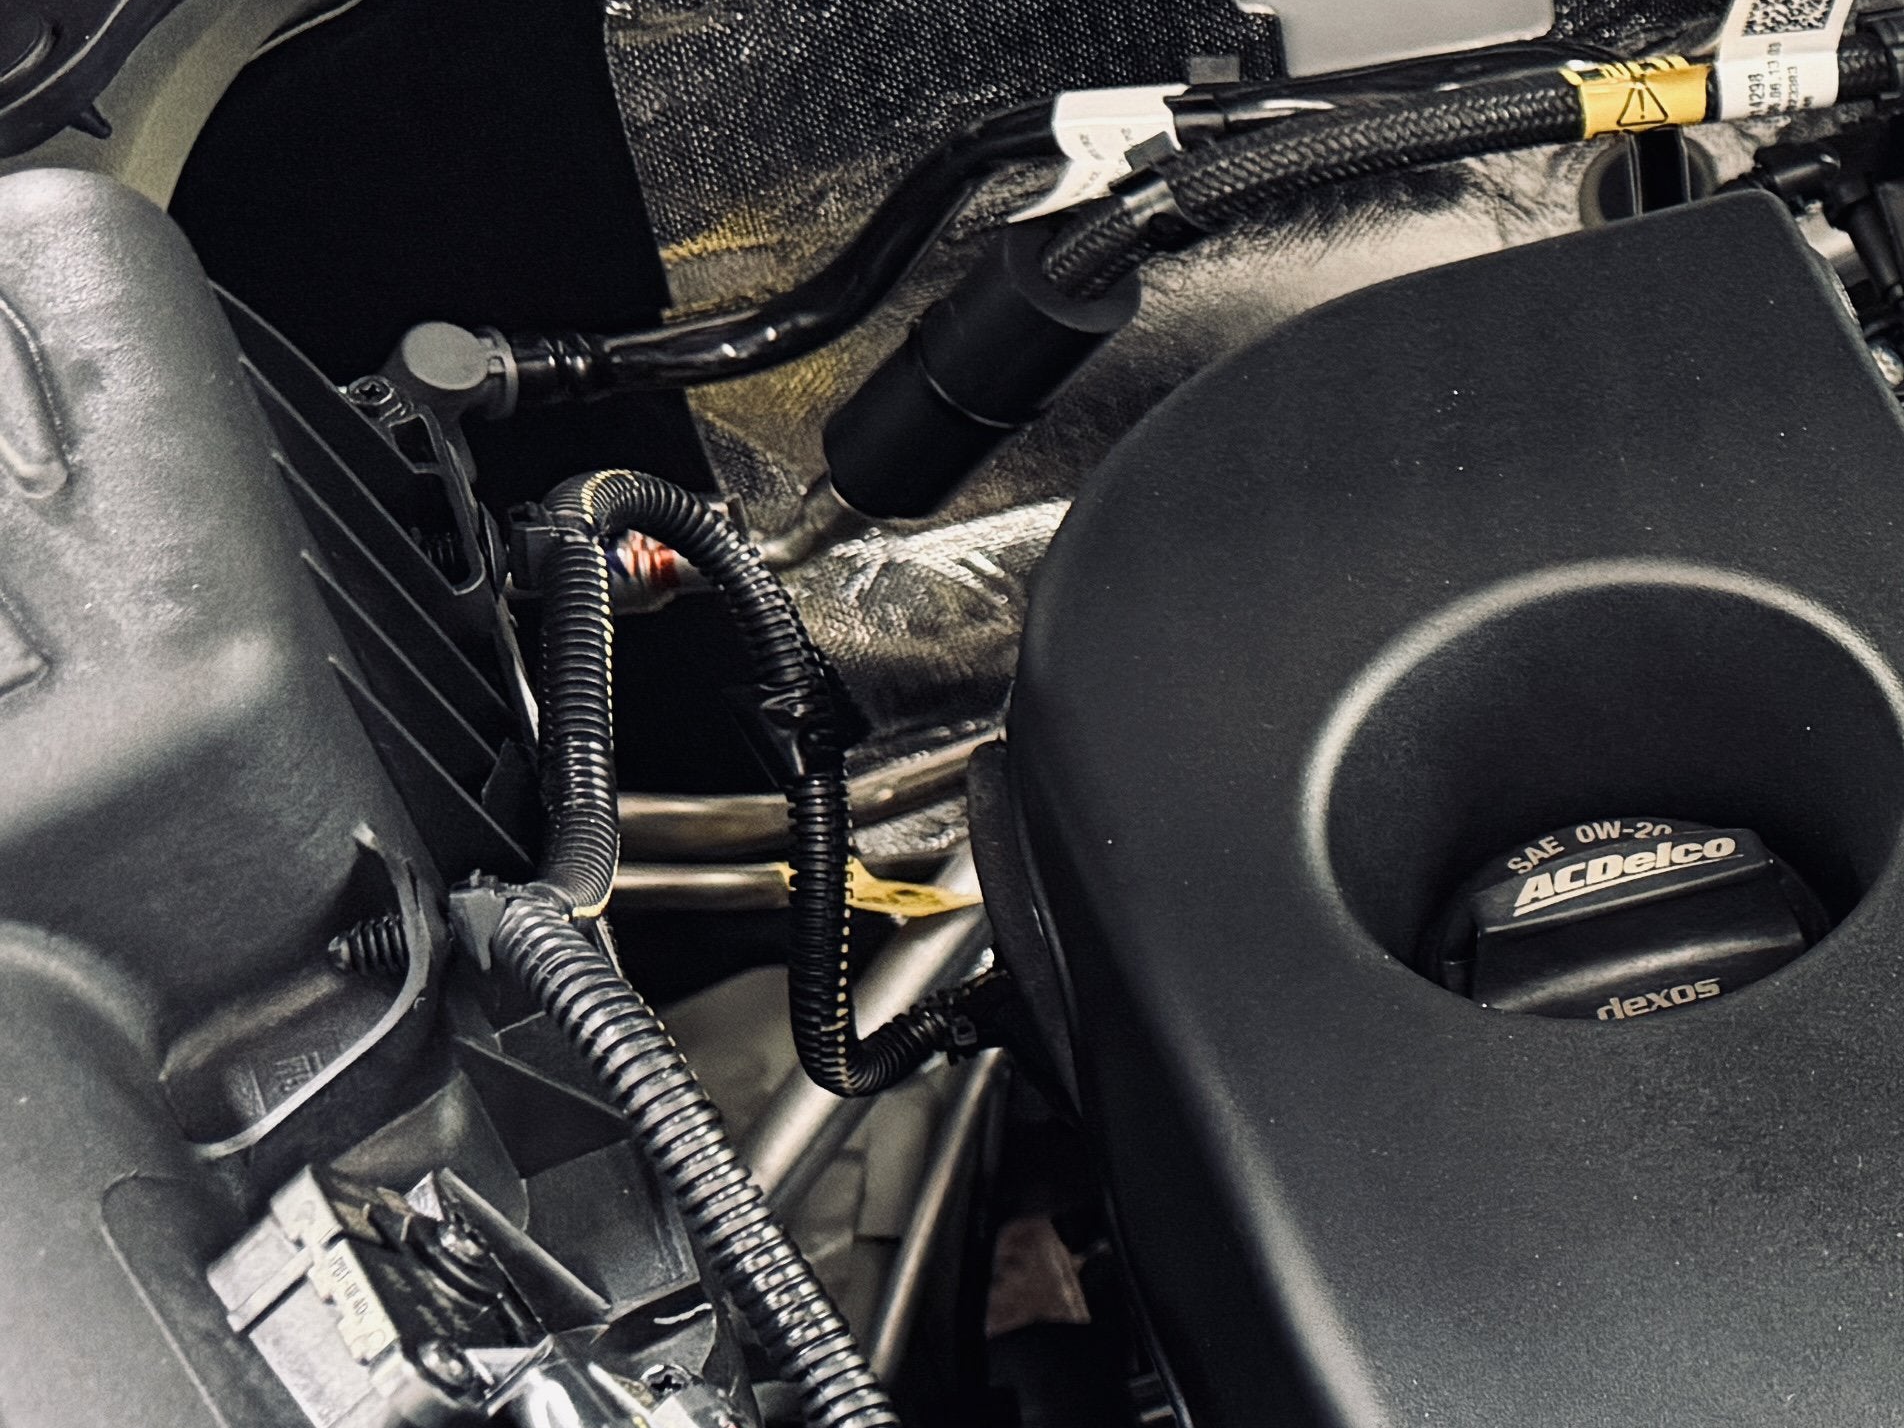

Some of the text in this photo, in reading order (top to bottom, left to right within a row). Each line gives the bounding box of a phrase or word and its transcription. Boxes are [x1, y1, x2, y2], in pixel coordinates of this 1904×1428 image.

[1507, 836, 1565, 876] SAE
[1513, 837, 1737, 908] ACDelco
[1597, 978, 1721, 1021] dexos
